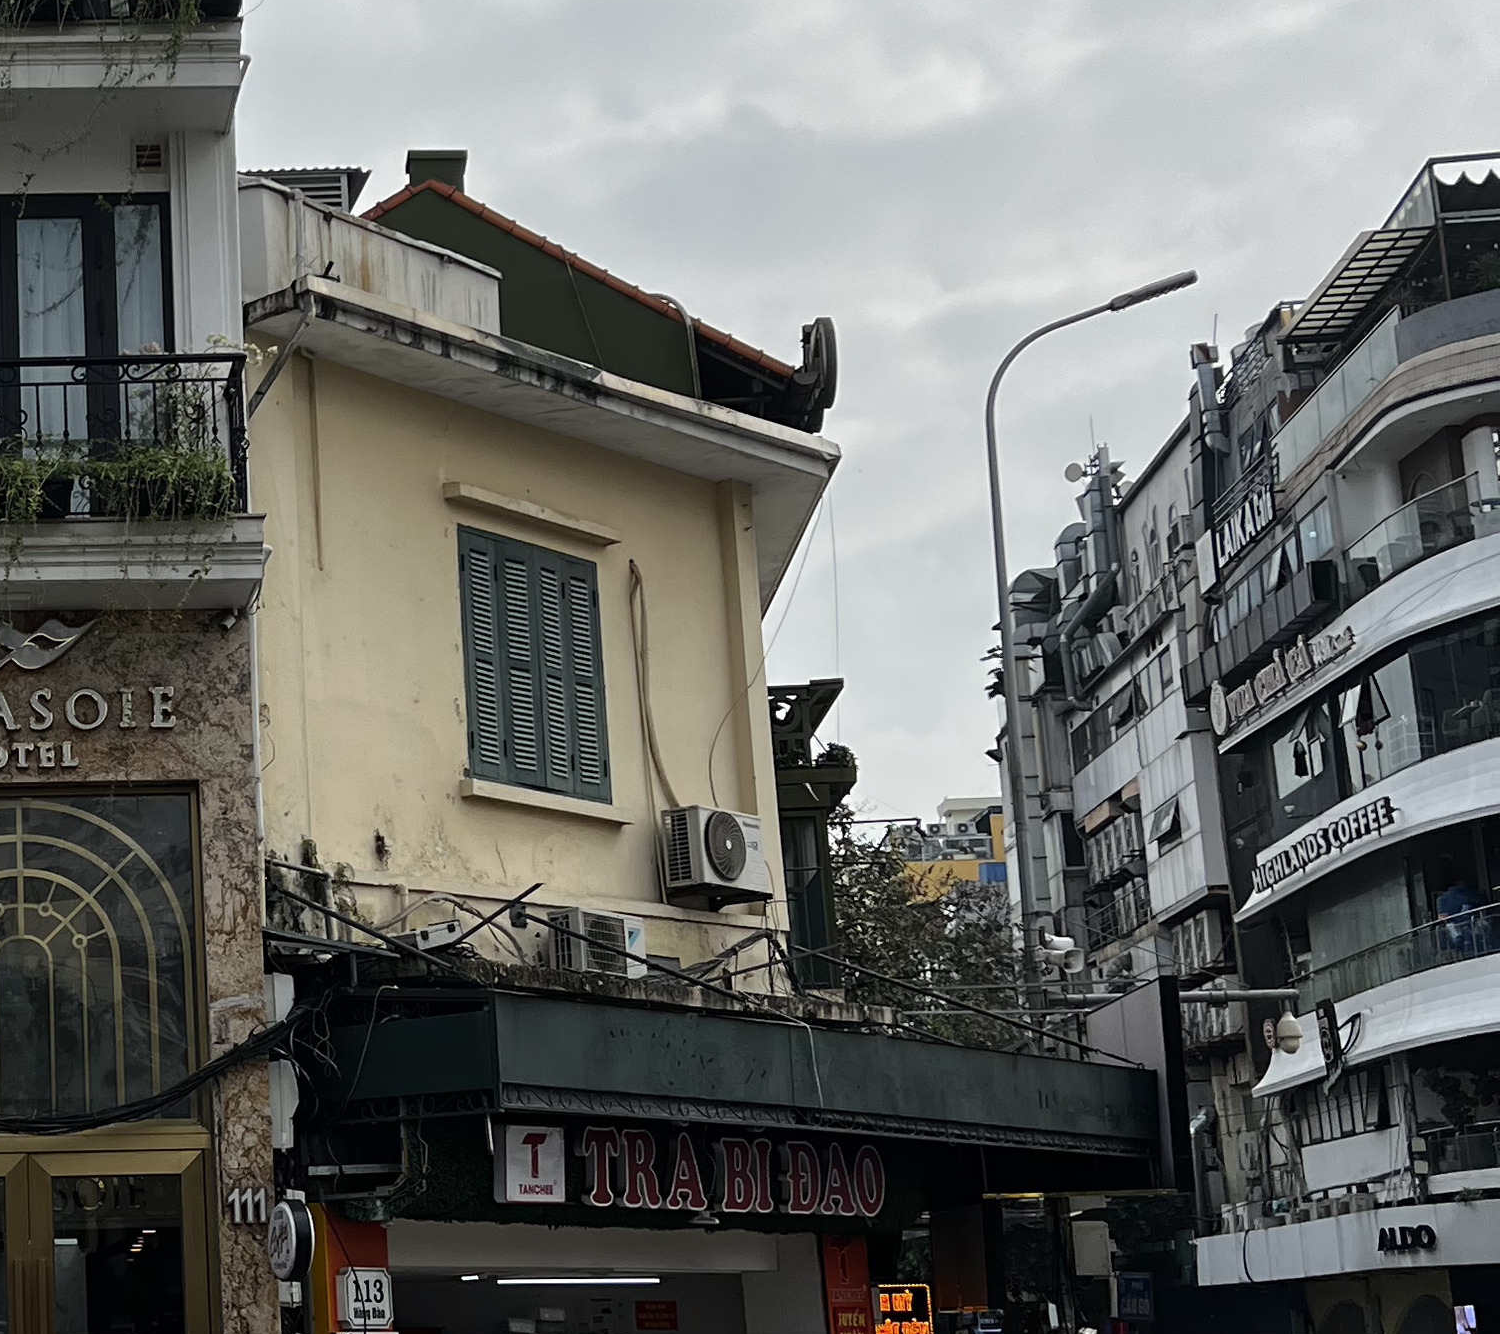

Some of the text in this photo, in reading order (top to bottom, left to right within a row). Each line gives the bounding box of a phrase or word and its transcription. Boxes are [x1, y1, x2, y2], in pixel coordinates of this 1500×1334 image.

[1251, 796, 1394, 894] HIGHLANDS COFFEE
[518, 1183, 554, 1196] TANCHEE
[784, 1139, 886, 1217] ĐAO
[226, 1187, 268, 1226] 111
[1376, 1224, 1437, 1253] ALDO
[352, 1279, 385, 1304] 113
